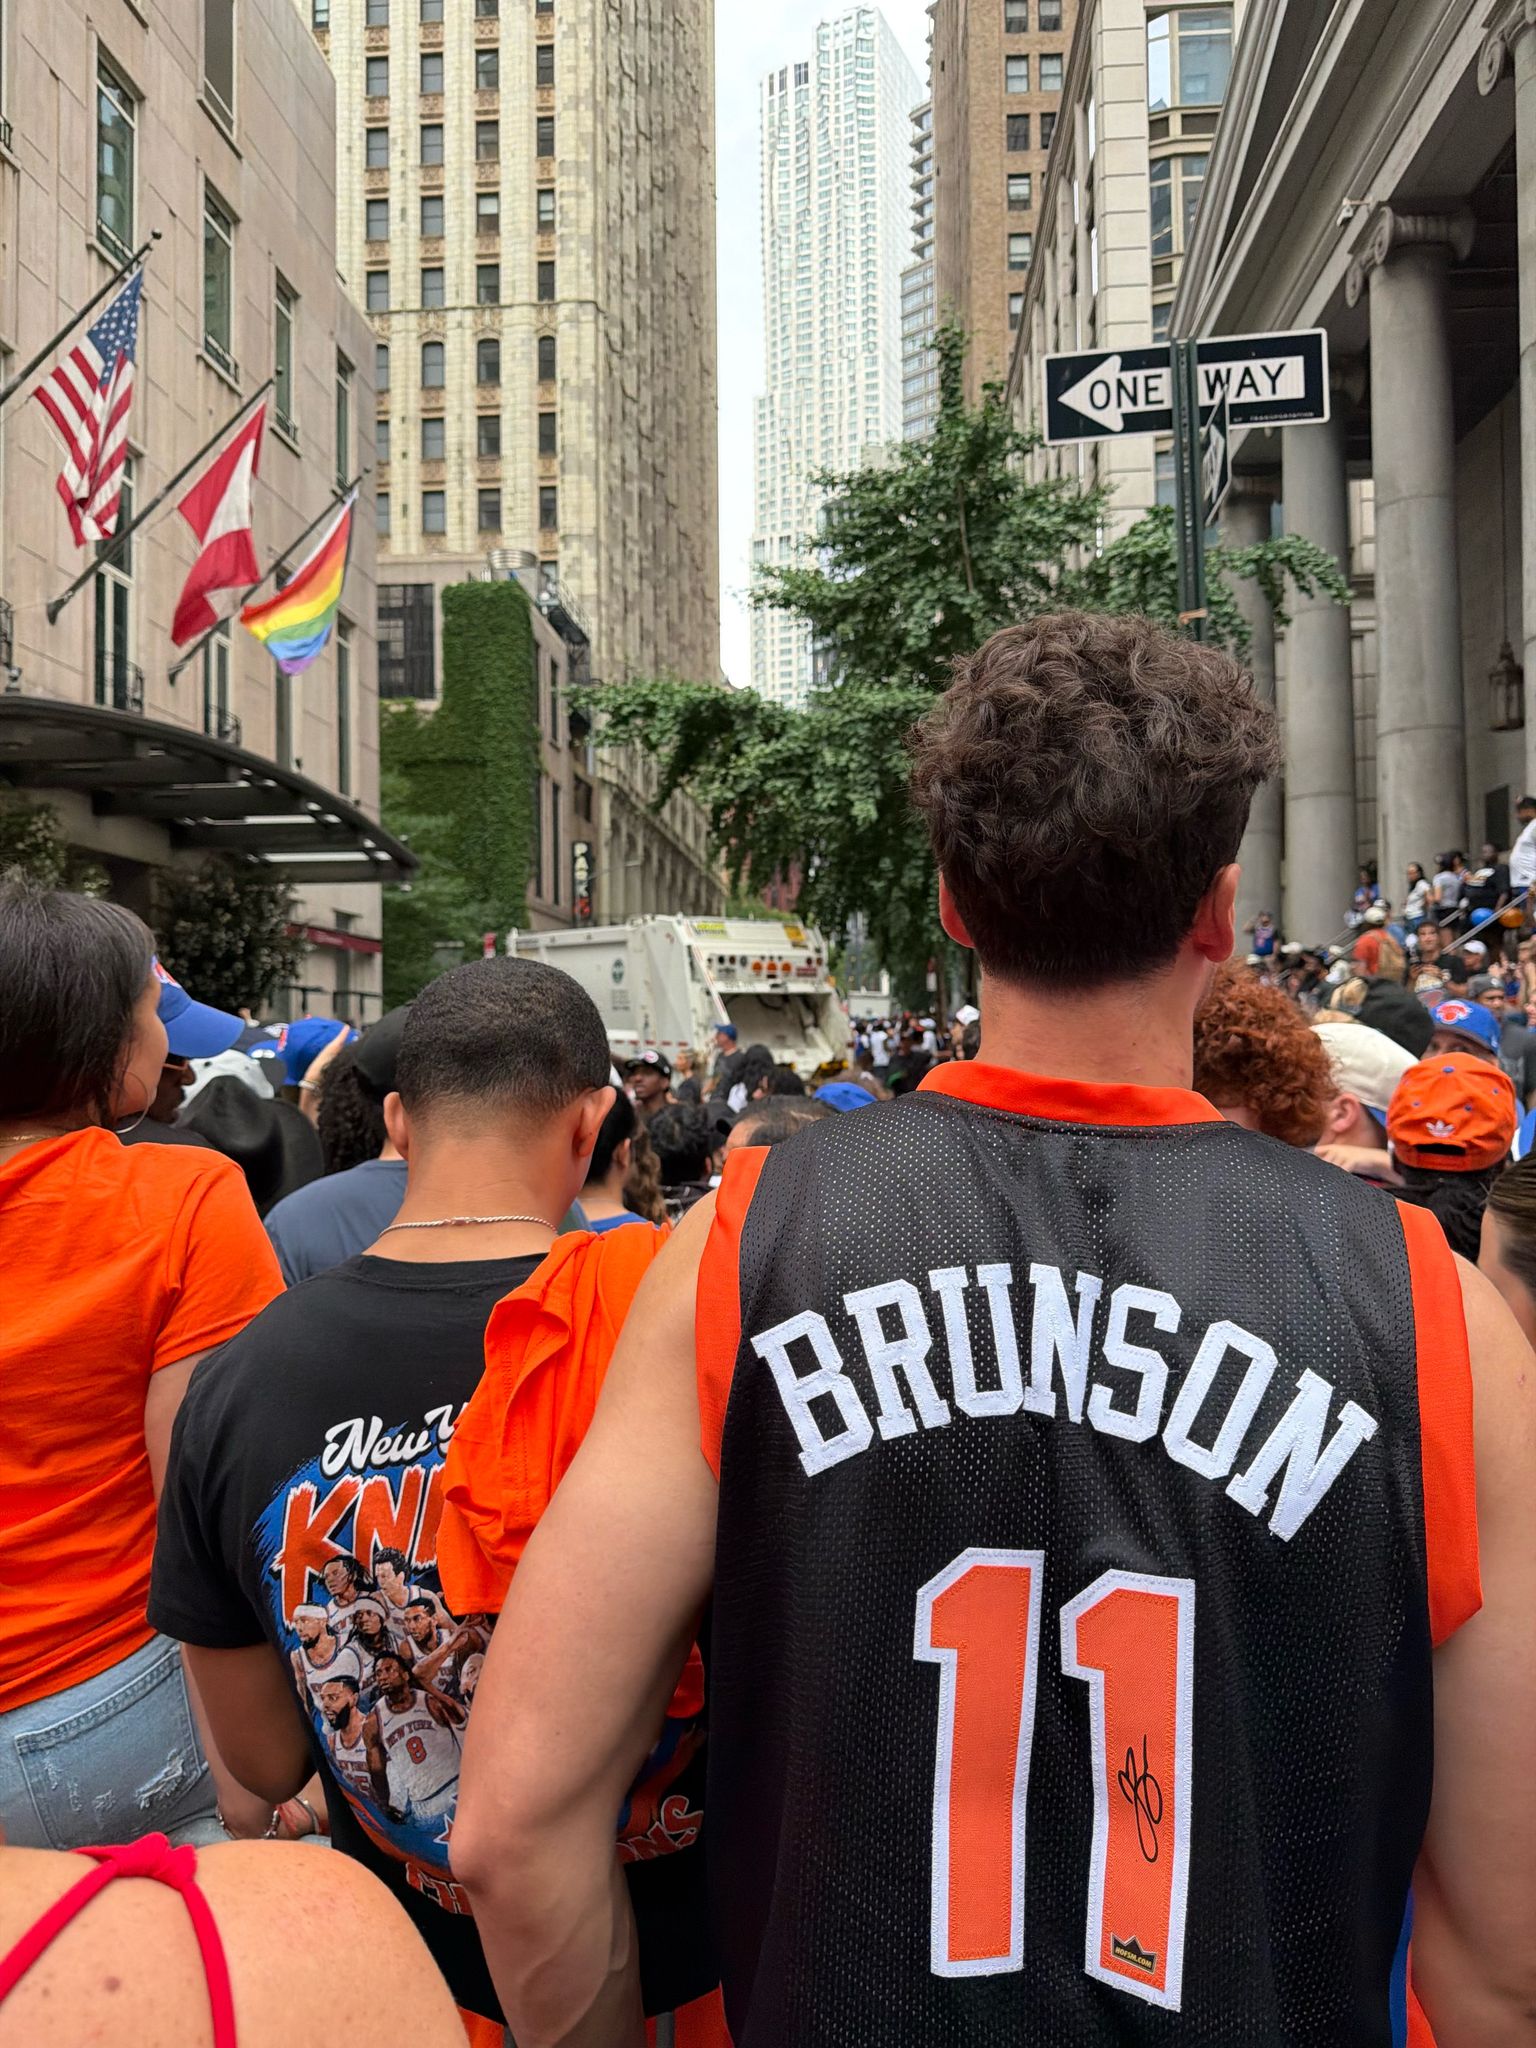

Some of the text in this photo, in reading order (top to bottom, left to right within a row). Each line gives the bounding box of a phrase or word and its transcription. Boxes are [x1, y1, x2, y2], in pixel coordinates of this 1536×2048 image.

[1089, 363, 1287, 410] ONE WAY
[750, 1262, 1378, 1543] BRUNSON
[321, 1415, 433, 1477] New
[406, 1736, 427, 1764] 8
[913, 1547, 1196, 2013] 11
[1114, 1946, 1152, 1969] HOFSM.COM
